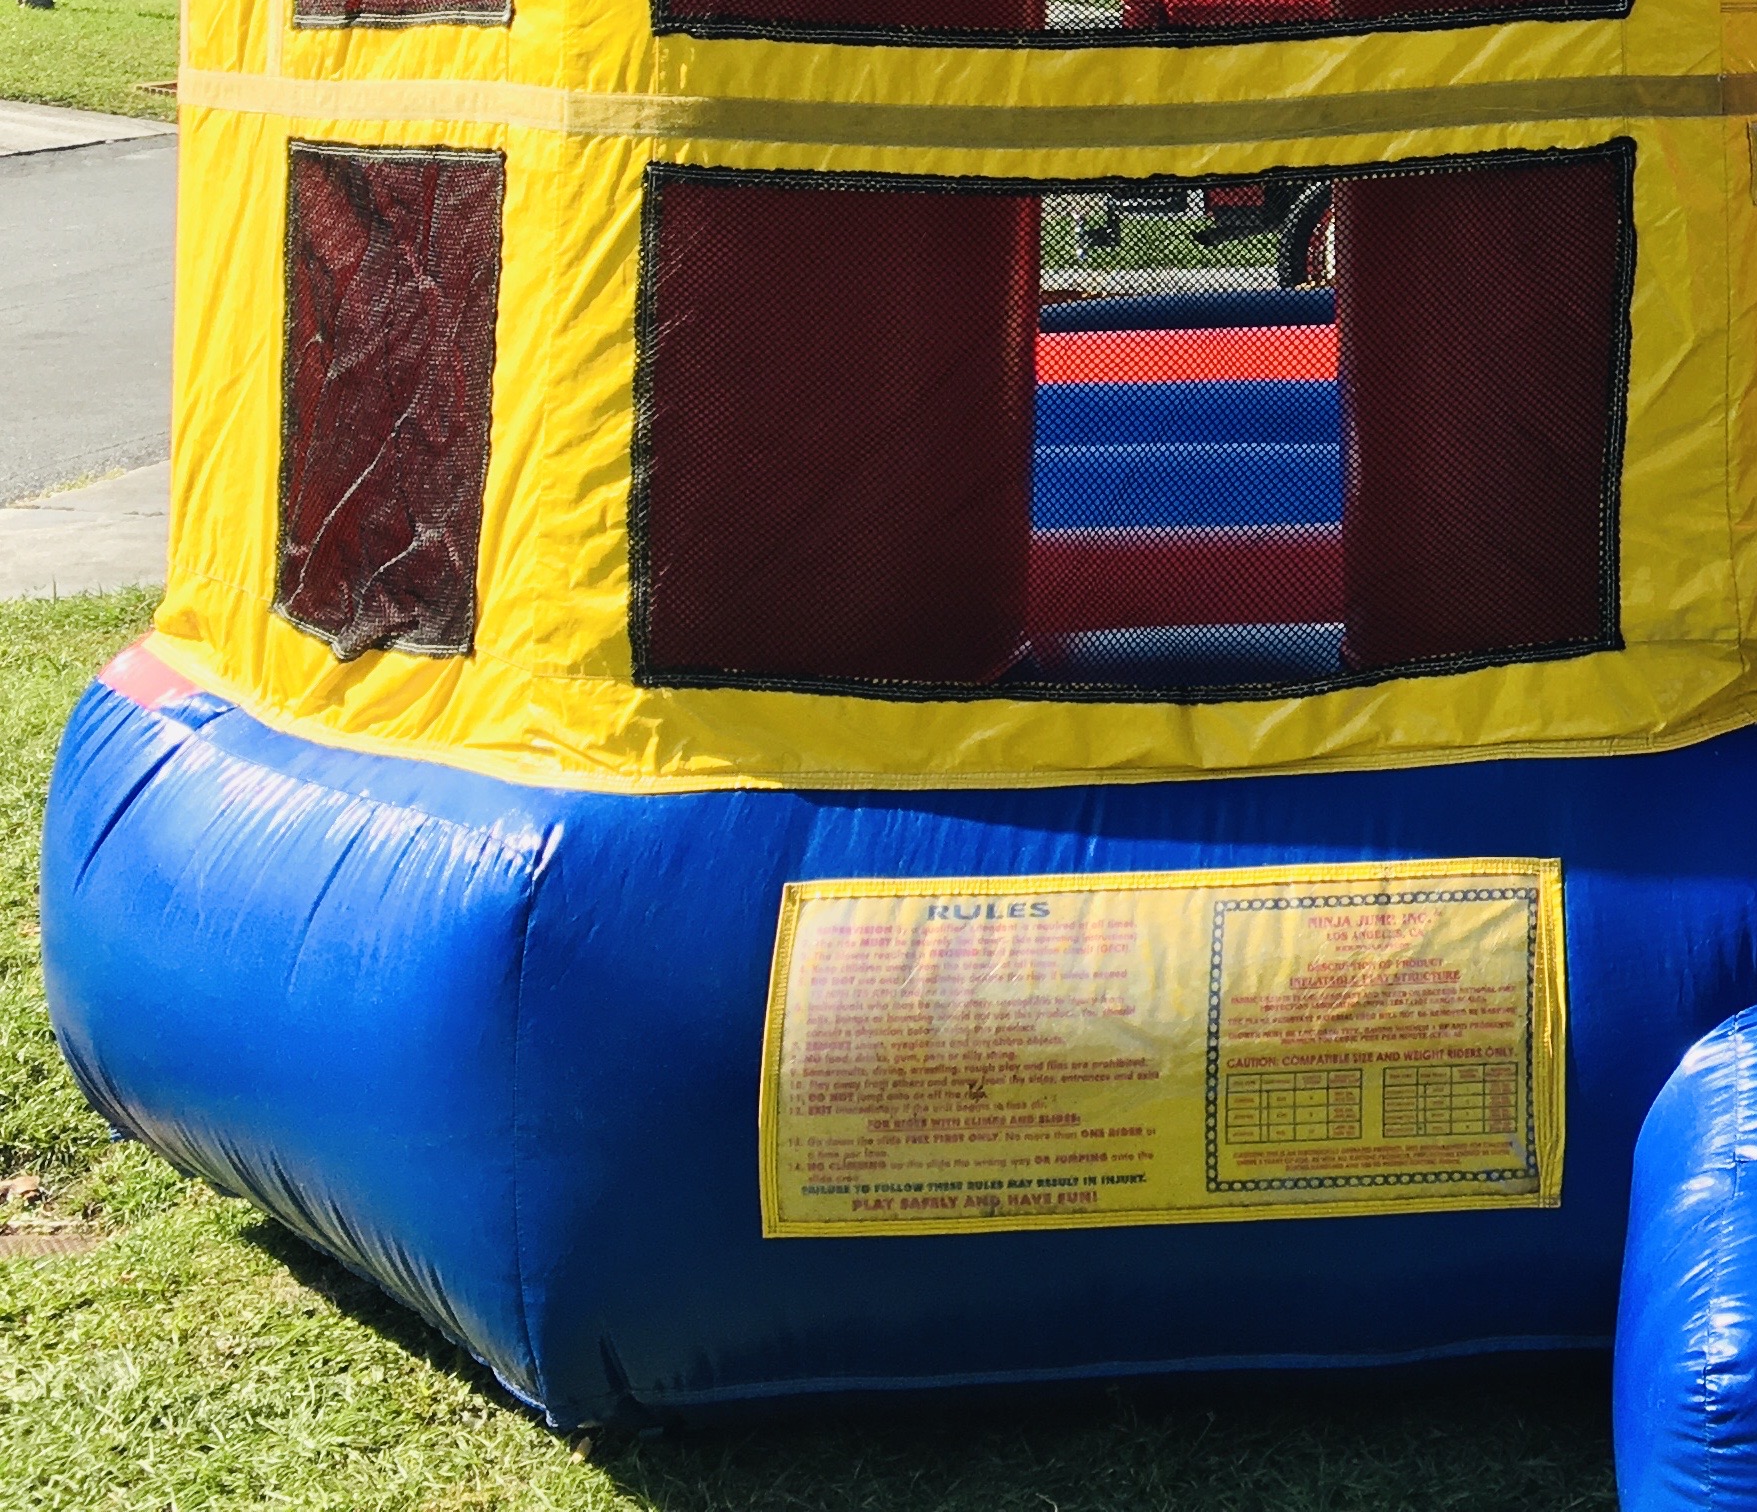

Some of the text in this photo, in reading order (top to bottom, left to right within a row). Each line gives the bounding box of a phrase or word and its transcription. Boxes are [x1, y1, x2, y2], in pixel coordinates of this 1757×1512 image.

[926, 901, 1051, 921] RULES
[1307, 915, 1350, 930] NINJA
[1326, 931, 1348, 942] LOS
[1394, 969, 1461, 983] STRUCTURE
[1282, 1053, 1349, 1067] COMPATIBLE
[1352, 1052, 1373, 1063] SIZE
[1376, 1050, 1400, 1062] AND
[1403, 1048, 1444, 1061] WEIGHT
[873, 1181, 923, 1193] FOLLOW
[1007, 1177, 1032, 1188] MAY
[852, 1198, 893, 1211] PLAY
[964, 1193, 1001, 1207] AND
[1007, 1191, 1052, 1205] HAVE
[1057, 1189, 1098, 1203] FUN!
